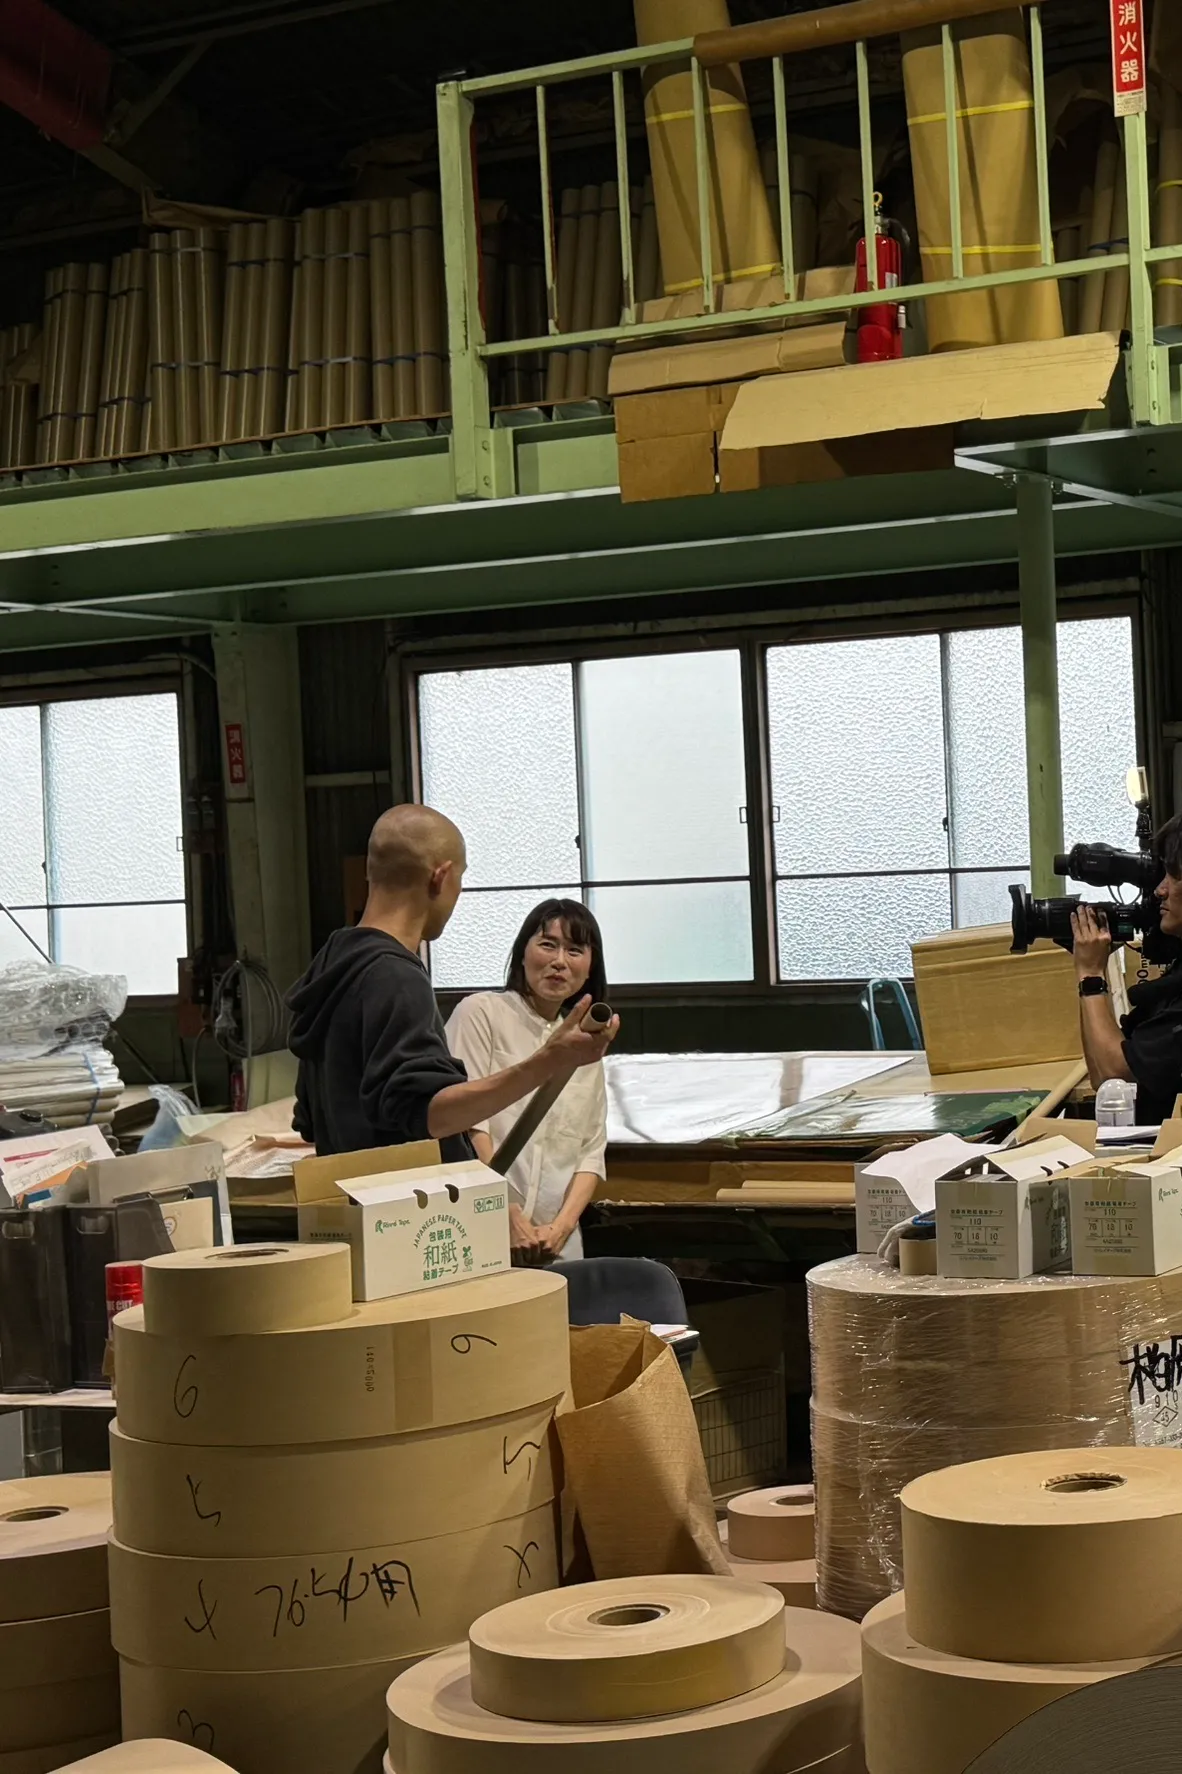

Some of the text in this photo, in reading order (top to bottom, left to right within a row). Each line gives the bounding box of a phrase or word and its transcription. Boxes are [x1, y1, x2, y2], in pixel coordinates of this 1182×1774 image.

[1118, 1, 1139, 83] 消火器
[1104, 1208, 1117, 1216] 110
[969, 1217, 982, 1226] 110
[413, 1216, 437, 1249] JAPANESE
[437, 1214, 457, 1225] PAPER
[1088, 1223, 1098, 1231] 70
[1124, 1223, 1134, 1231] 10
[953, 1231, 963, 1240] 70
[989, 1232, 999, 1241] 10
[423, 1240, 458, 1268] 和紙
[423, 1263, 459, 1281] 粘着テープ
[173, 1354, 198, 1418] 6
